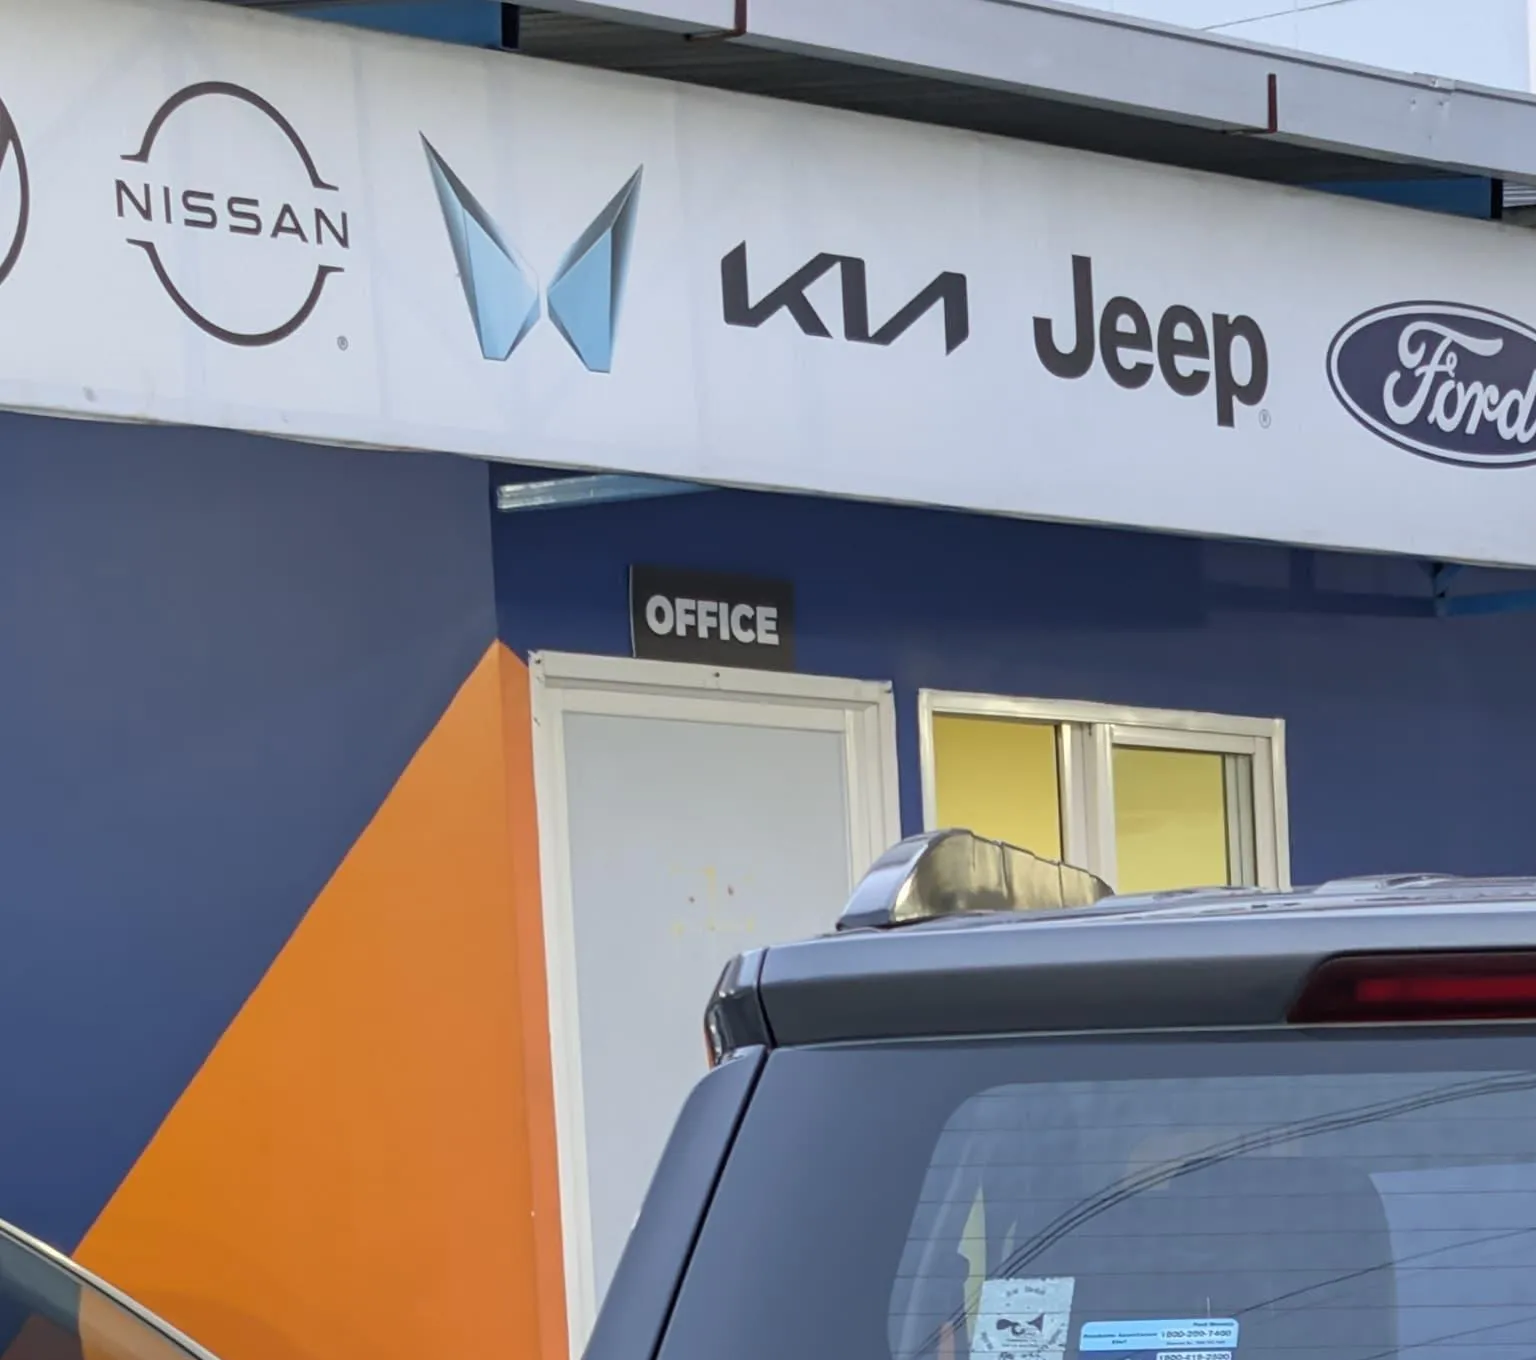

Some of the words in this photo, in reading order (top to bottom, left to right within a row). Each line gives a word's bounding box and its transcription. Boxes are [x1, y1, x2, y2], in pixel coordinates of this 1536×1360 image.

[115, 179, 350, 249] NISSAN
[1032, 254, 1268, 427] Jeep
[646, 594, 780, 645] OFFICE
